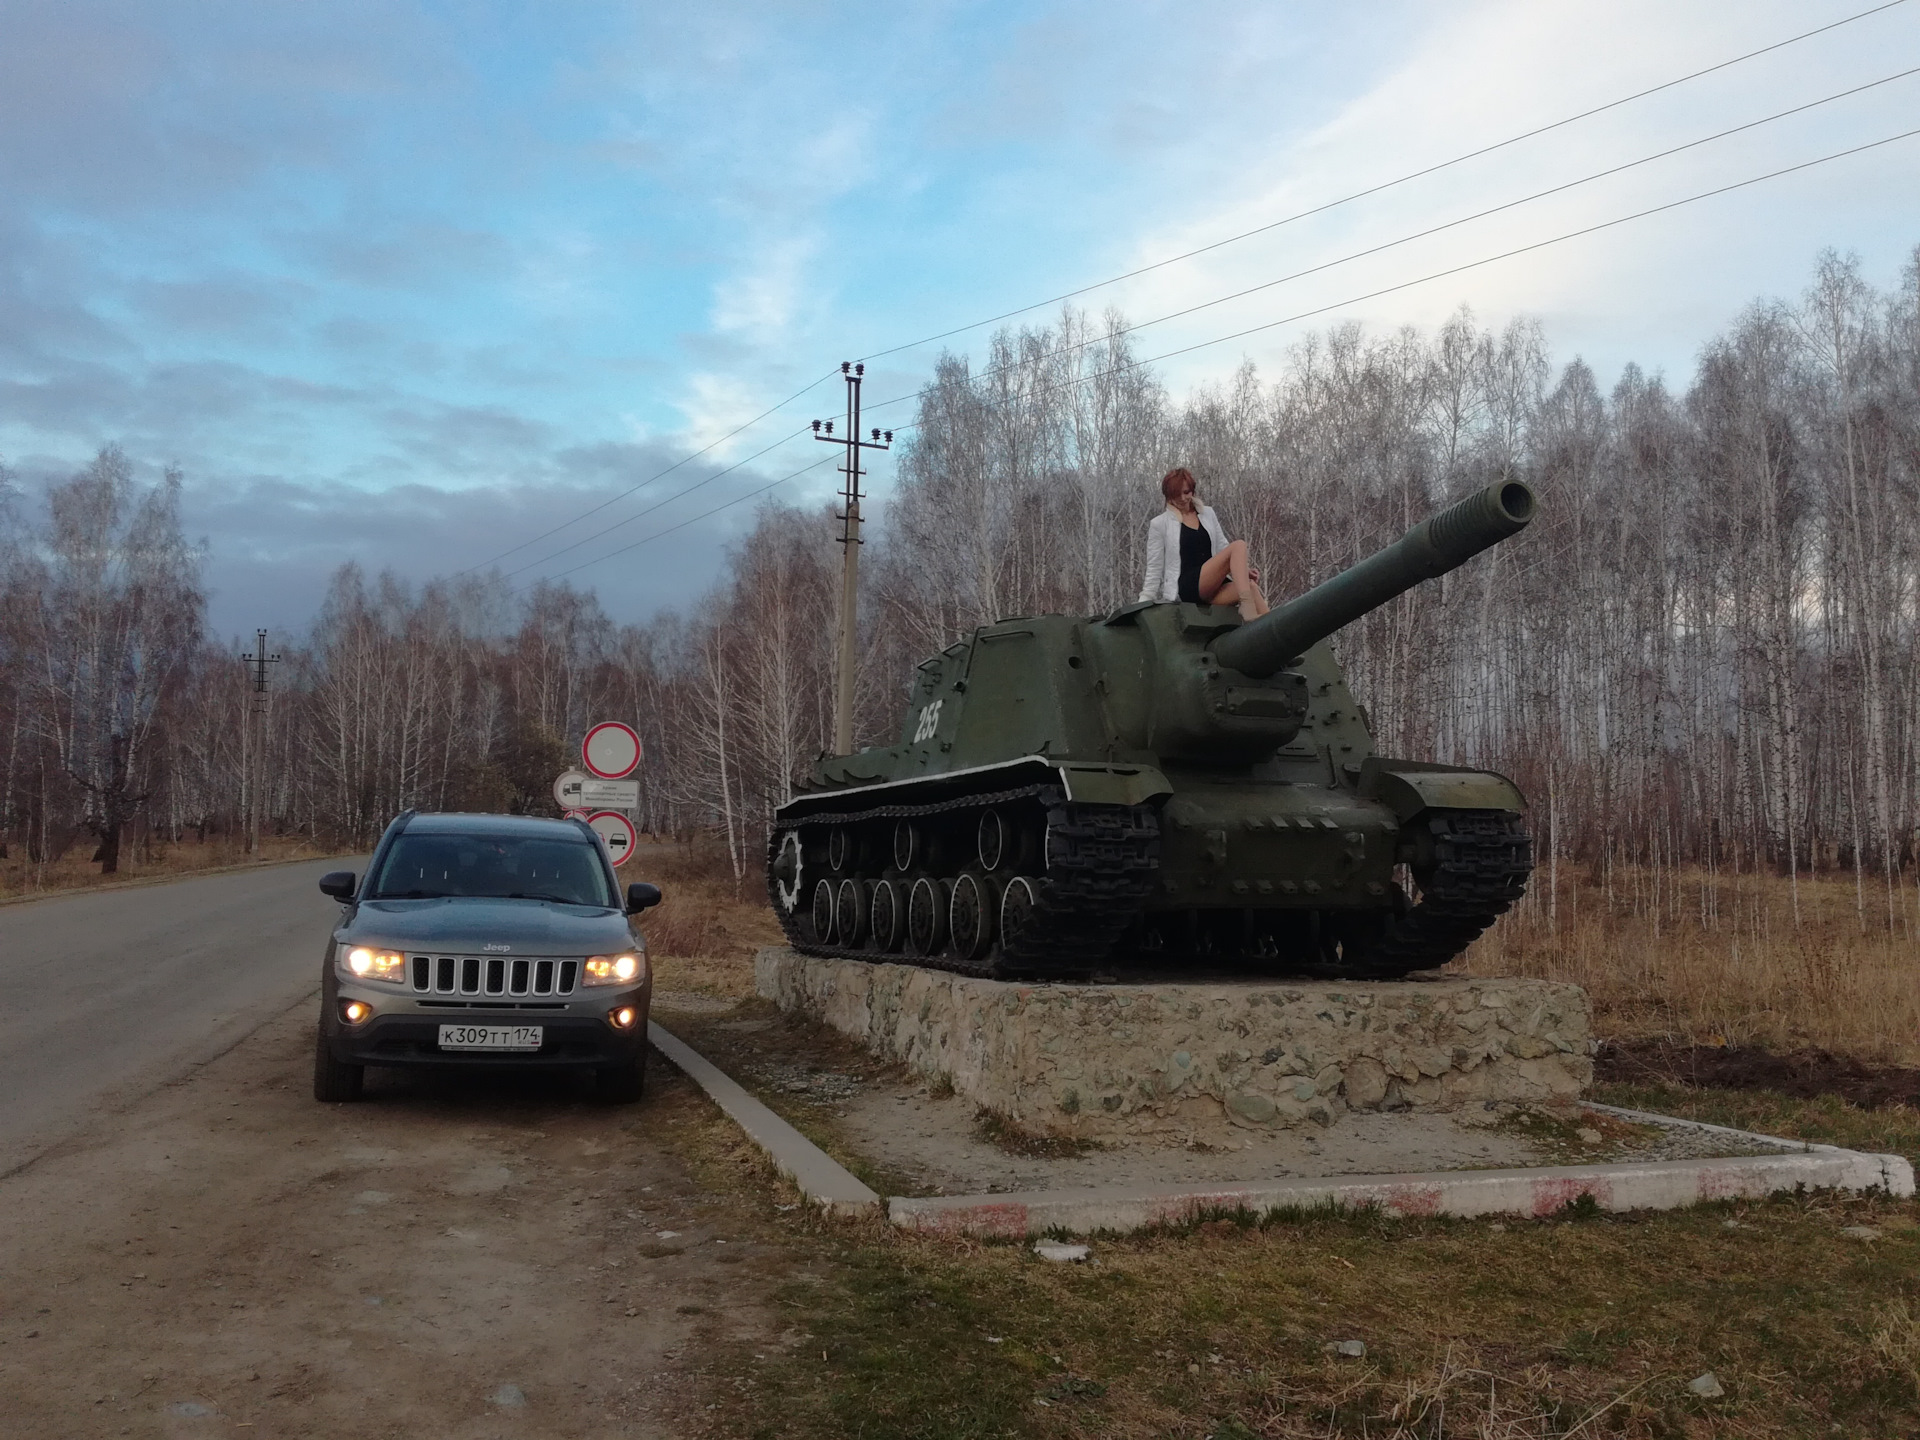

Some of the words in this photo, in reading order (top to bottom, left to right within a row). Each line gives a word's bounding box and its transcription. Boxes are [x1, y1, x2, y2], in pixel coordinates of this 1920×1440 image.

[914, 699, 943, 744] 255
[483, 943, 510, 953] Jeep
[514, 1028, 538, 1041] 174
